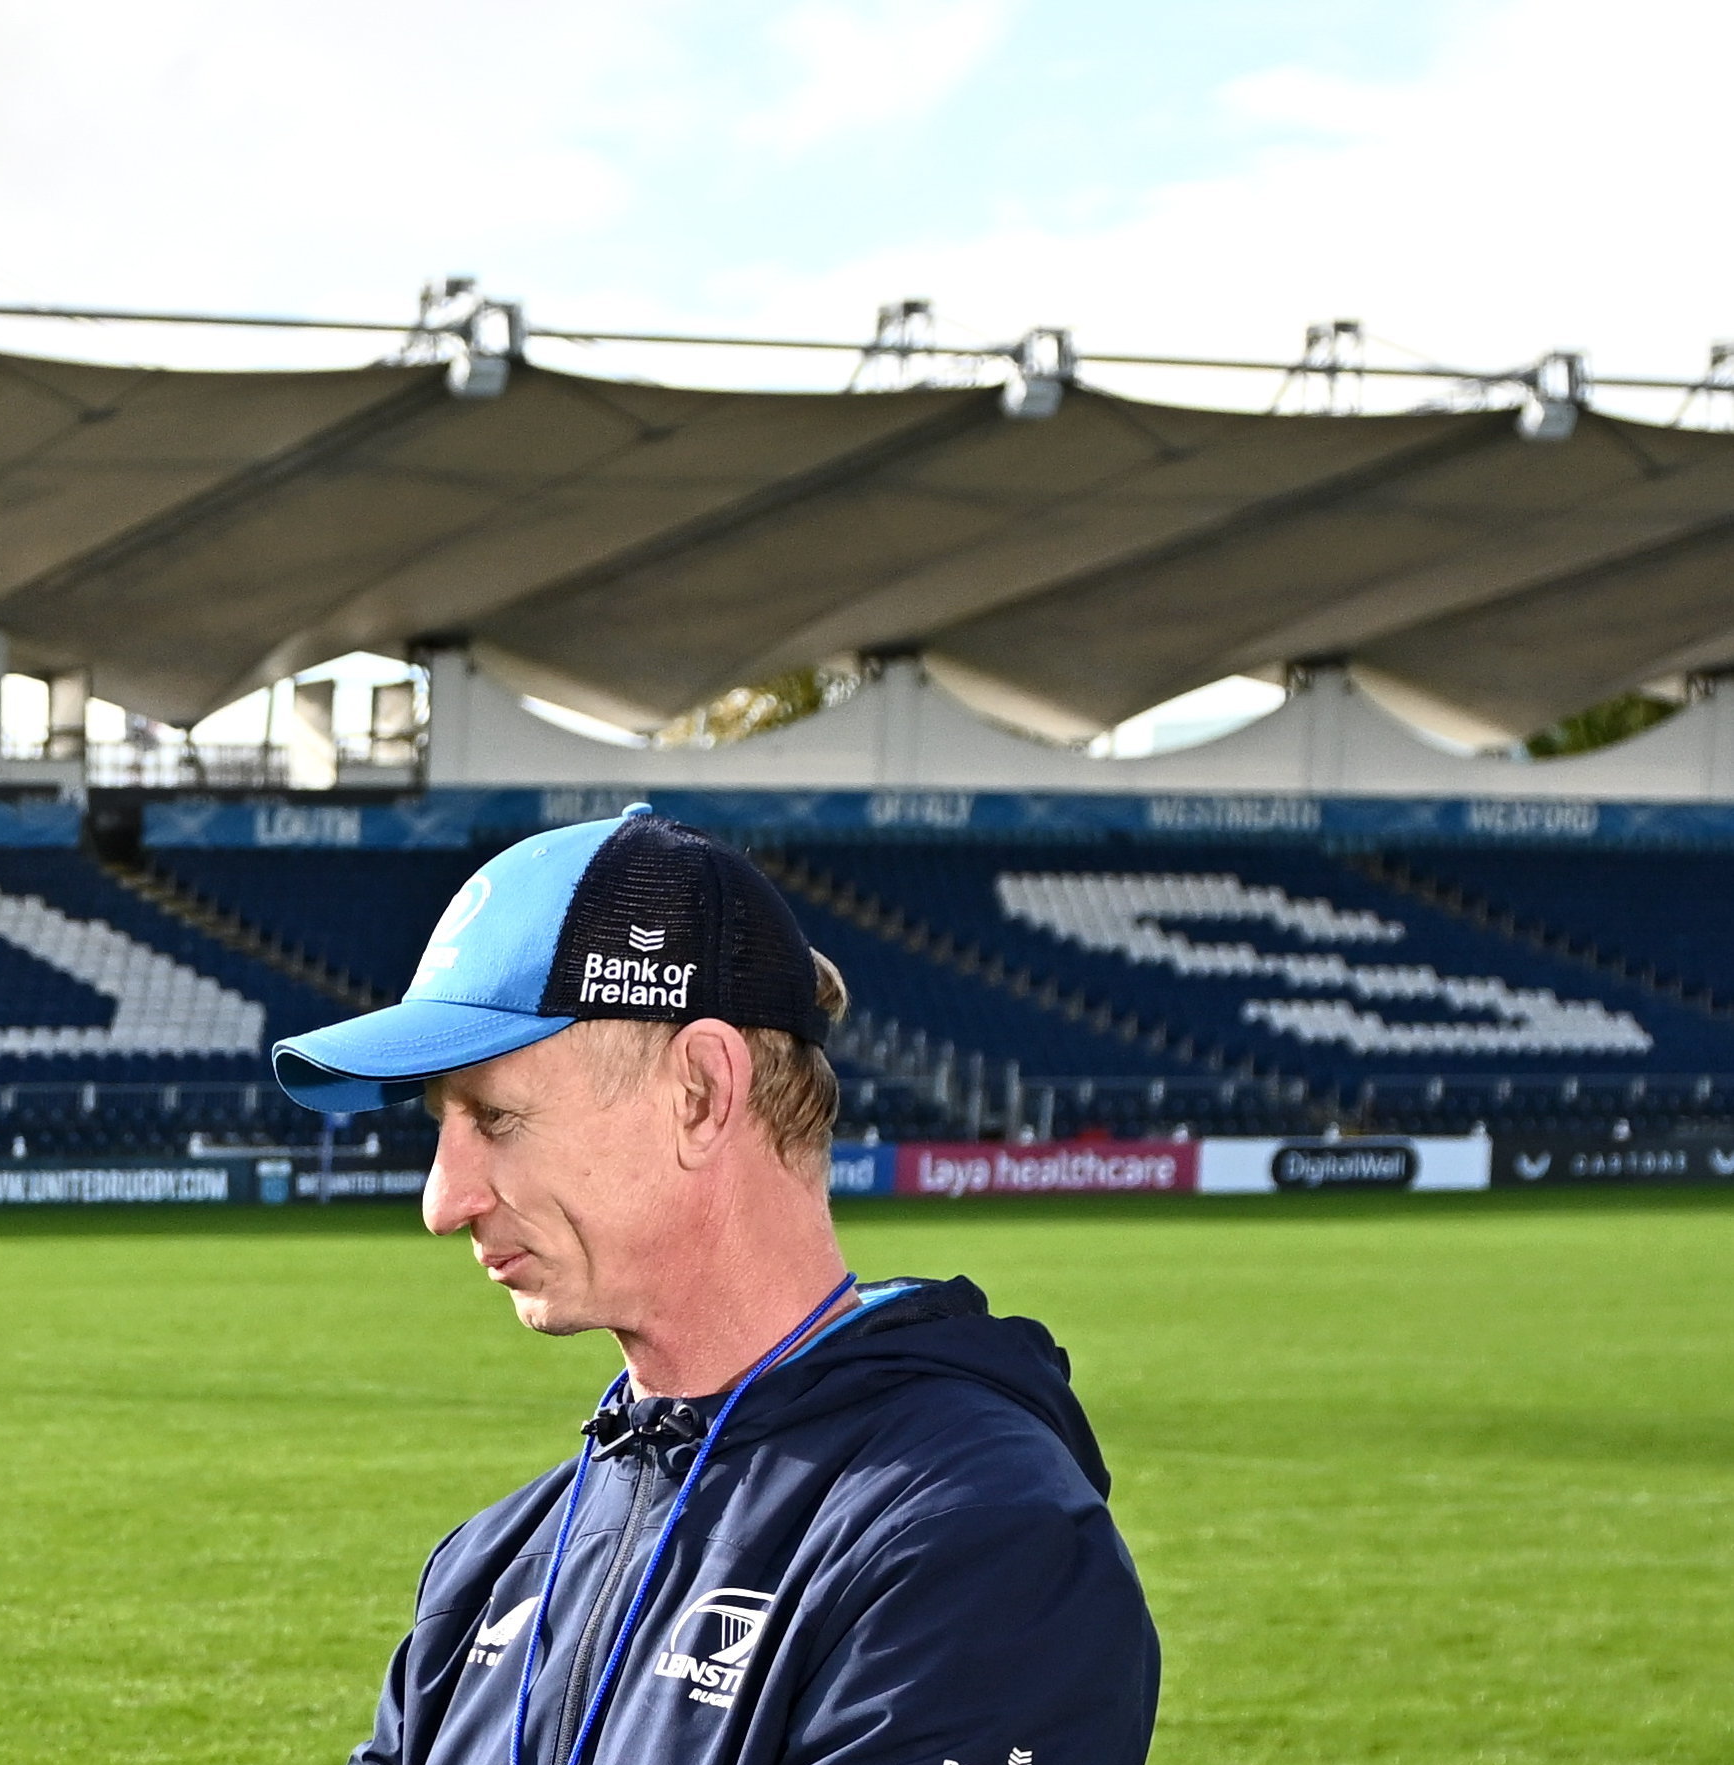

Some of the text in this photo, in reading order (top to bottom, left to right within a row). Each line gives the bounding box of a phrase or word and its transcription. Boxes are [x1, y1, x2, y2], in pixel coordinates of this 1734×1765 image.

[253, 806, 363, 846] LOUTH
[584, 953, 697, 987] Bank of
[579, 978, 688, 1009] Ireland
[918, 1152, 991, 1198] laya
[995, 1150, 1176, 1190] healthcare
